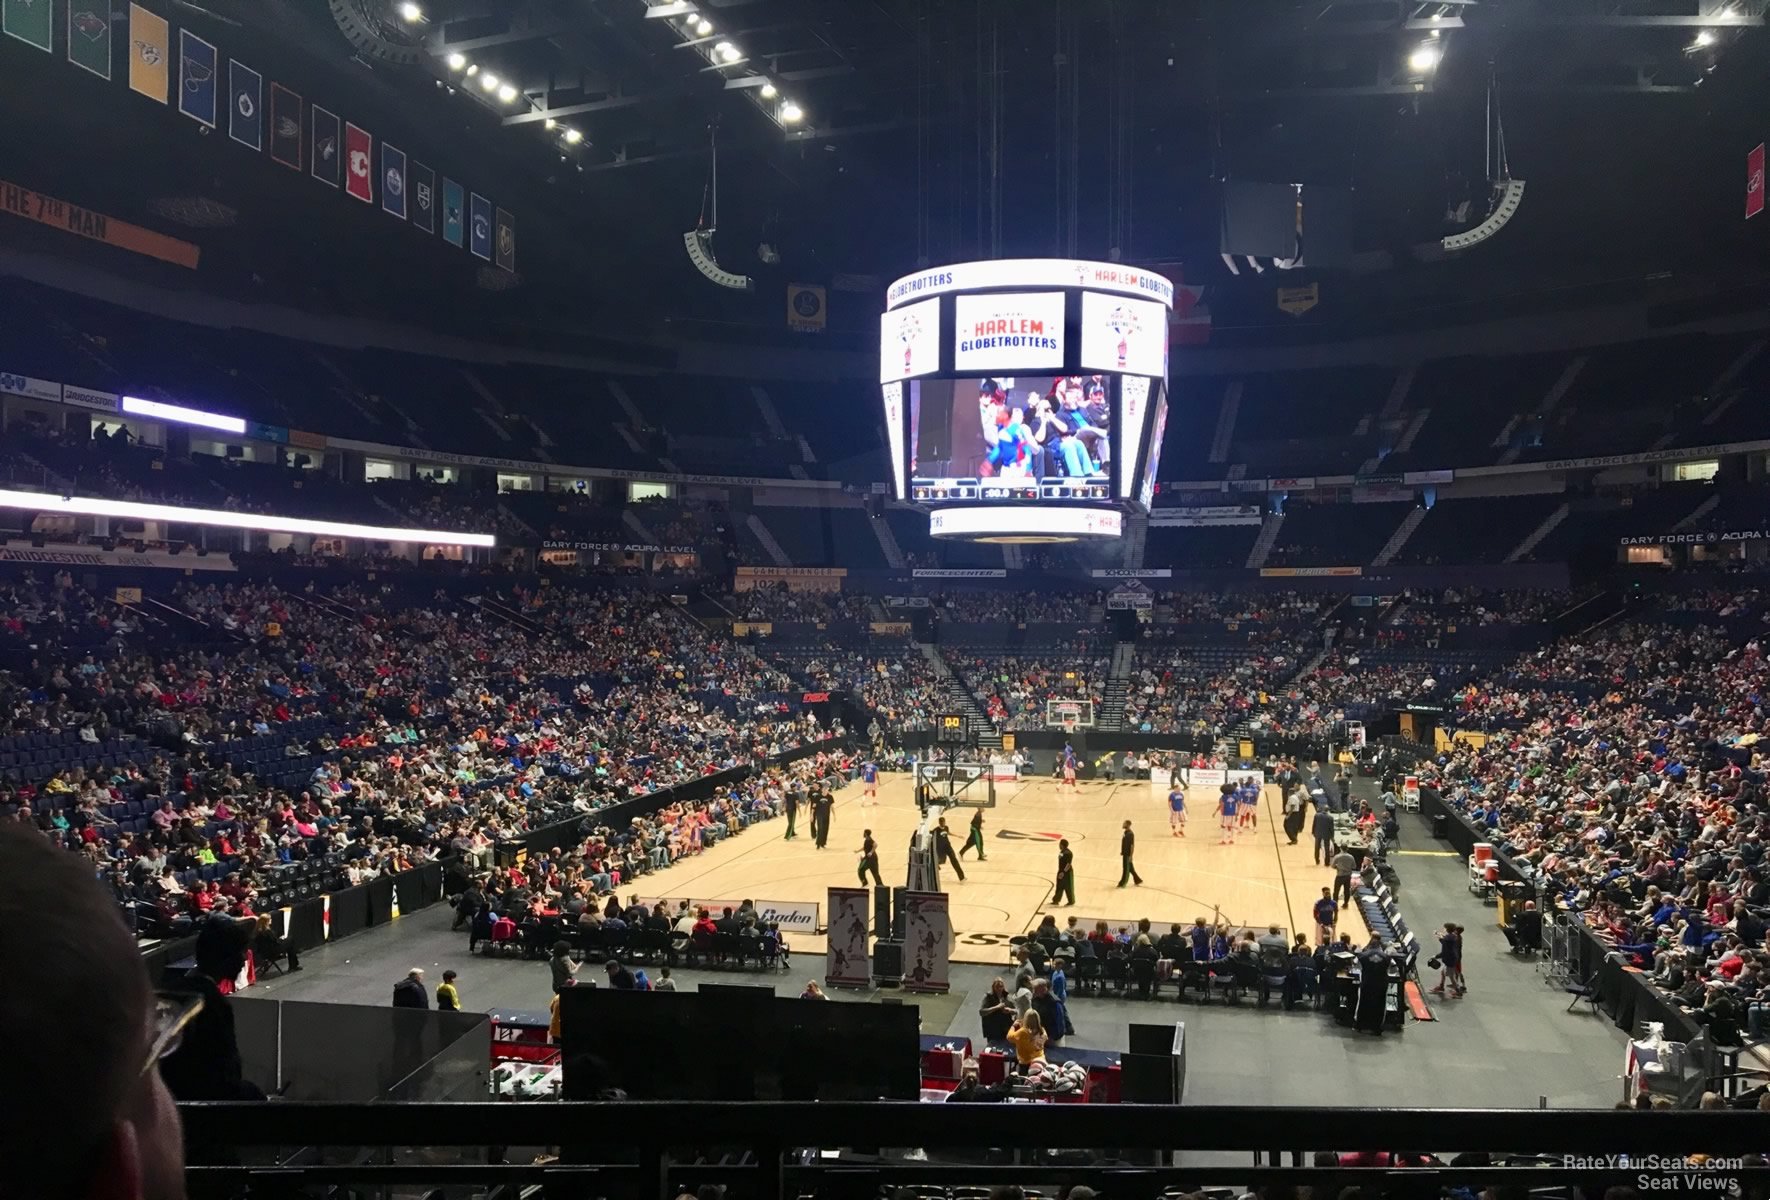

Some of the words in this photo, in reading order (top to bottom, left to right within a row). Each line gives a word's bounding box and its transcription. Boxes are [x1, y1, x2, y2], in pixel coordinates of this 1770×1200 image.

[36, 192, 64, 220] 7TH
[68, 205, 107, 239] MAN
[1095, 270, 1138, 285] HARLEM
[975, 319, 1044, 337] HARLEM
[961, 335, 1058, 352] GLOBETROTTERS
[65, 390, 117, 407] BRIDGESTONE
[478, 458, 514, 467] ACURA
[1545, 460, 1578, 470] GARY
[1584, 456, 1628, 466] FORCE
[1643, 450, 1685, 460] ACURA
[1621, 536, 1654, 544] GARY
[1659, 534, 1704, 542] FORCE
[1721, 531, 1762, 540] ACURA
[575, 542, 609, 550] FORCE
[664, 546, 697, 554] LEVEL
[753, 567, 780, 575] GAME
[785, 568, 832, 576] CHANGER
[761, 909, 812, 924] Baden
